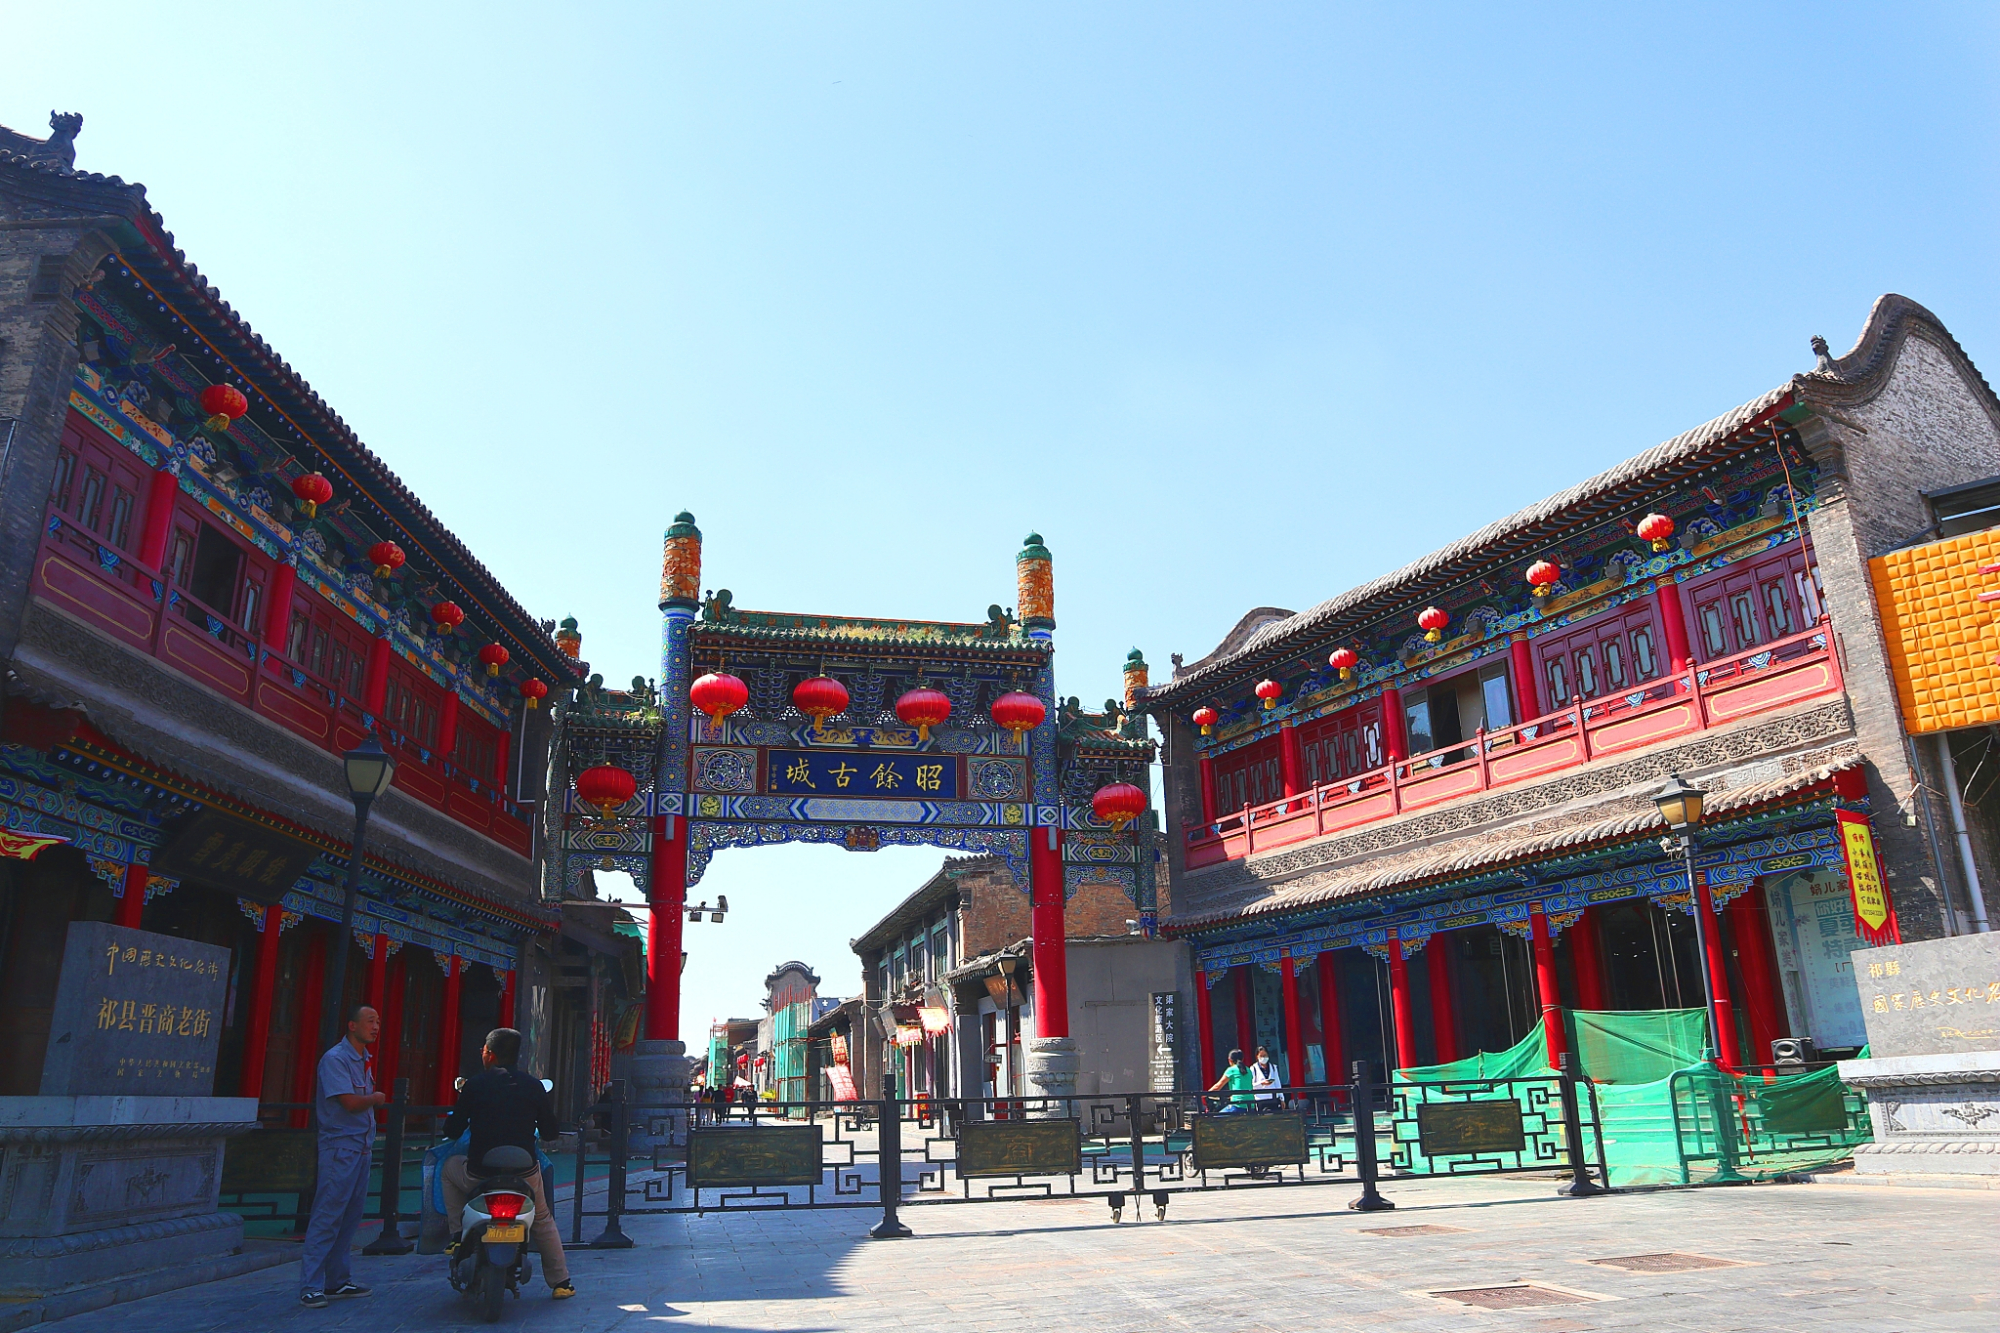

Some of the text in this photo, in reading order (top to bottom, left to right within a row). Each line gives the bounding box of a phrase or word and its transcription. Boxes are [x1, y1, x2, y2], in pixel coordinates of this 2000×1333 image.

[786, 757, 943, 791] 昭餘古城
[98, 997, 211, 1038] 祁县晋商老街
[1155, 996, 1163, 1043] 文化旅游区
[1165, 995, 1174, 1043] 渠家大院
